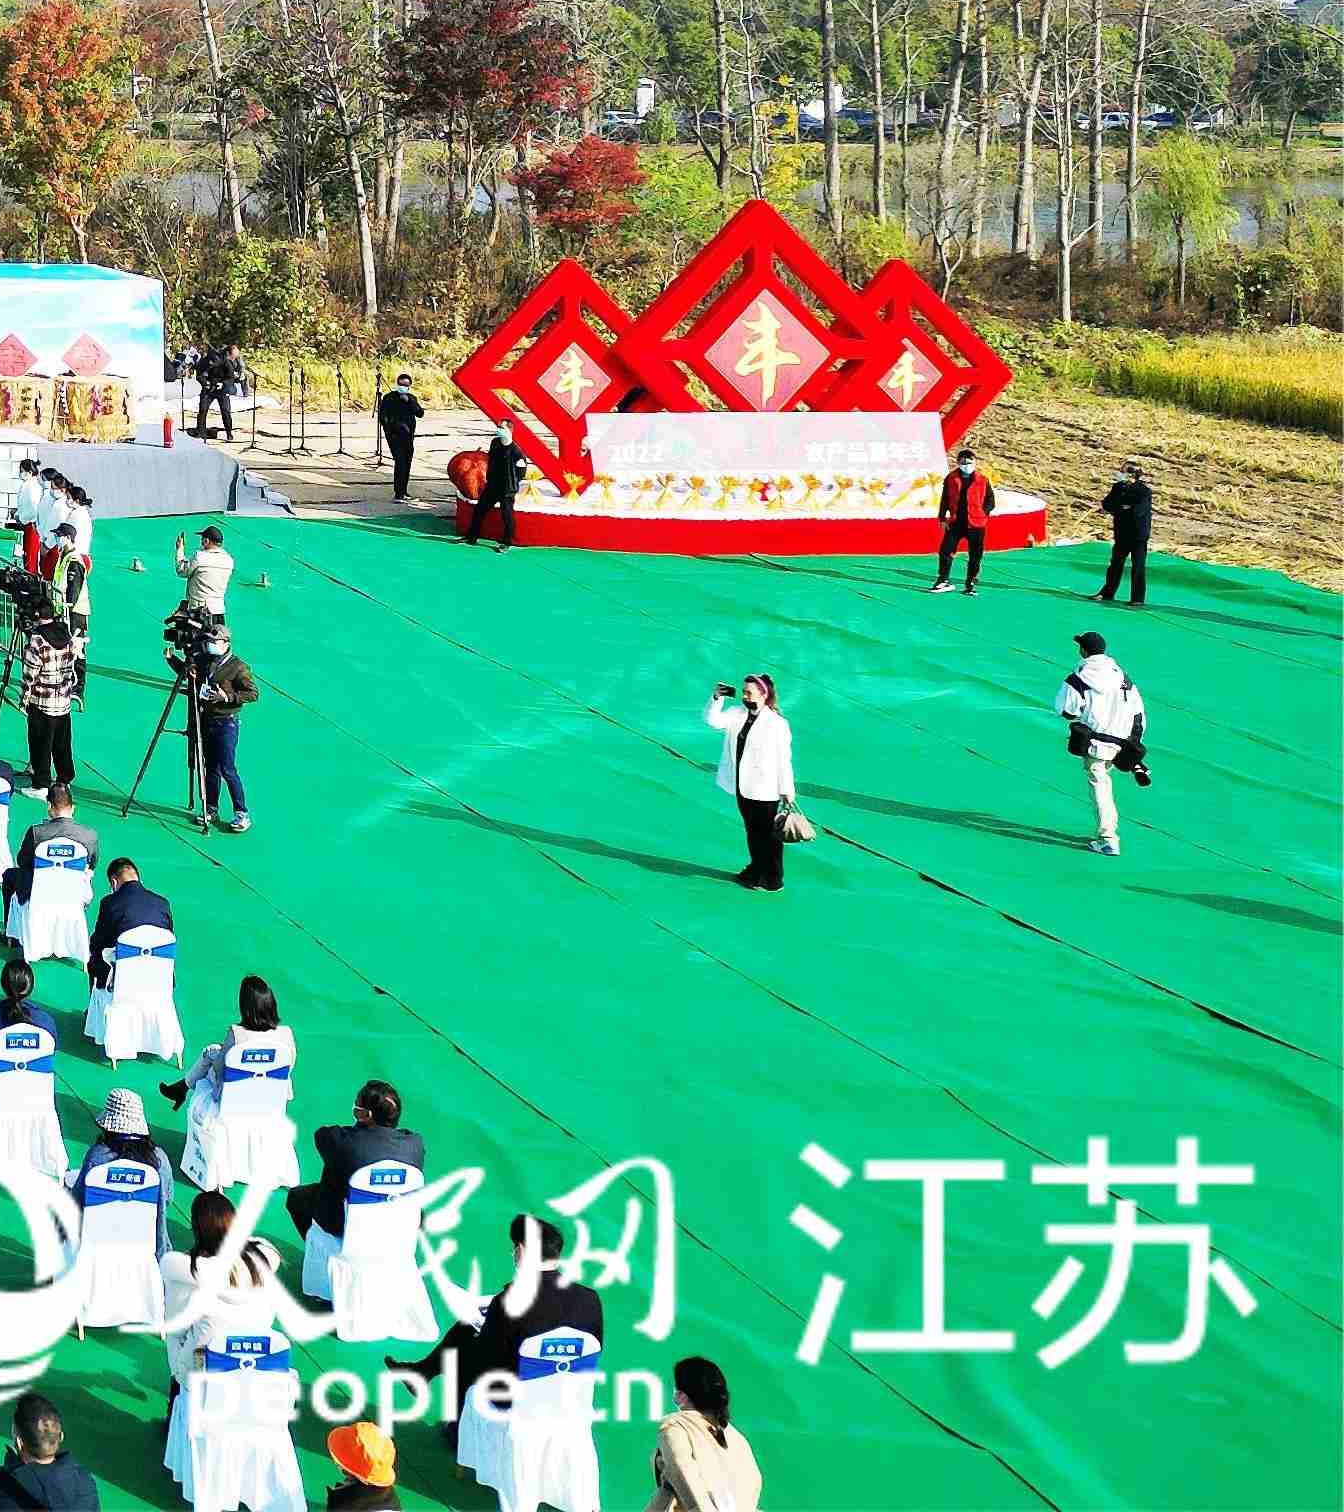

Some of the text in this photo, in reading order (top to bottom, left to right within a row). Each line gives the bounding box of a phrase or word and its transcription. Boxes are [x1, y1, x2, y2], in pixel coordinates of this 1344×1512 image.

[553, 352, 596, 413] 丰
[734, 301, 802, 408] 丰
[886, 347, 926, 409] 丰
